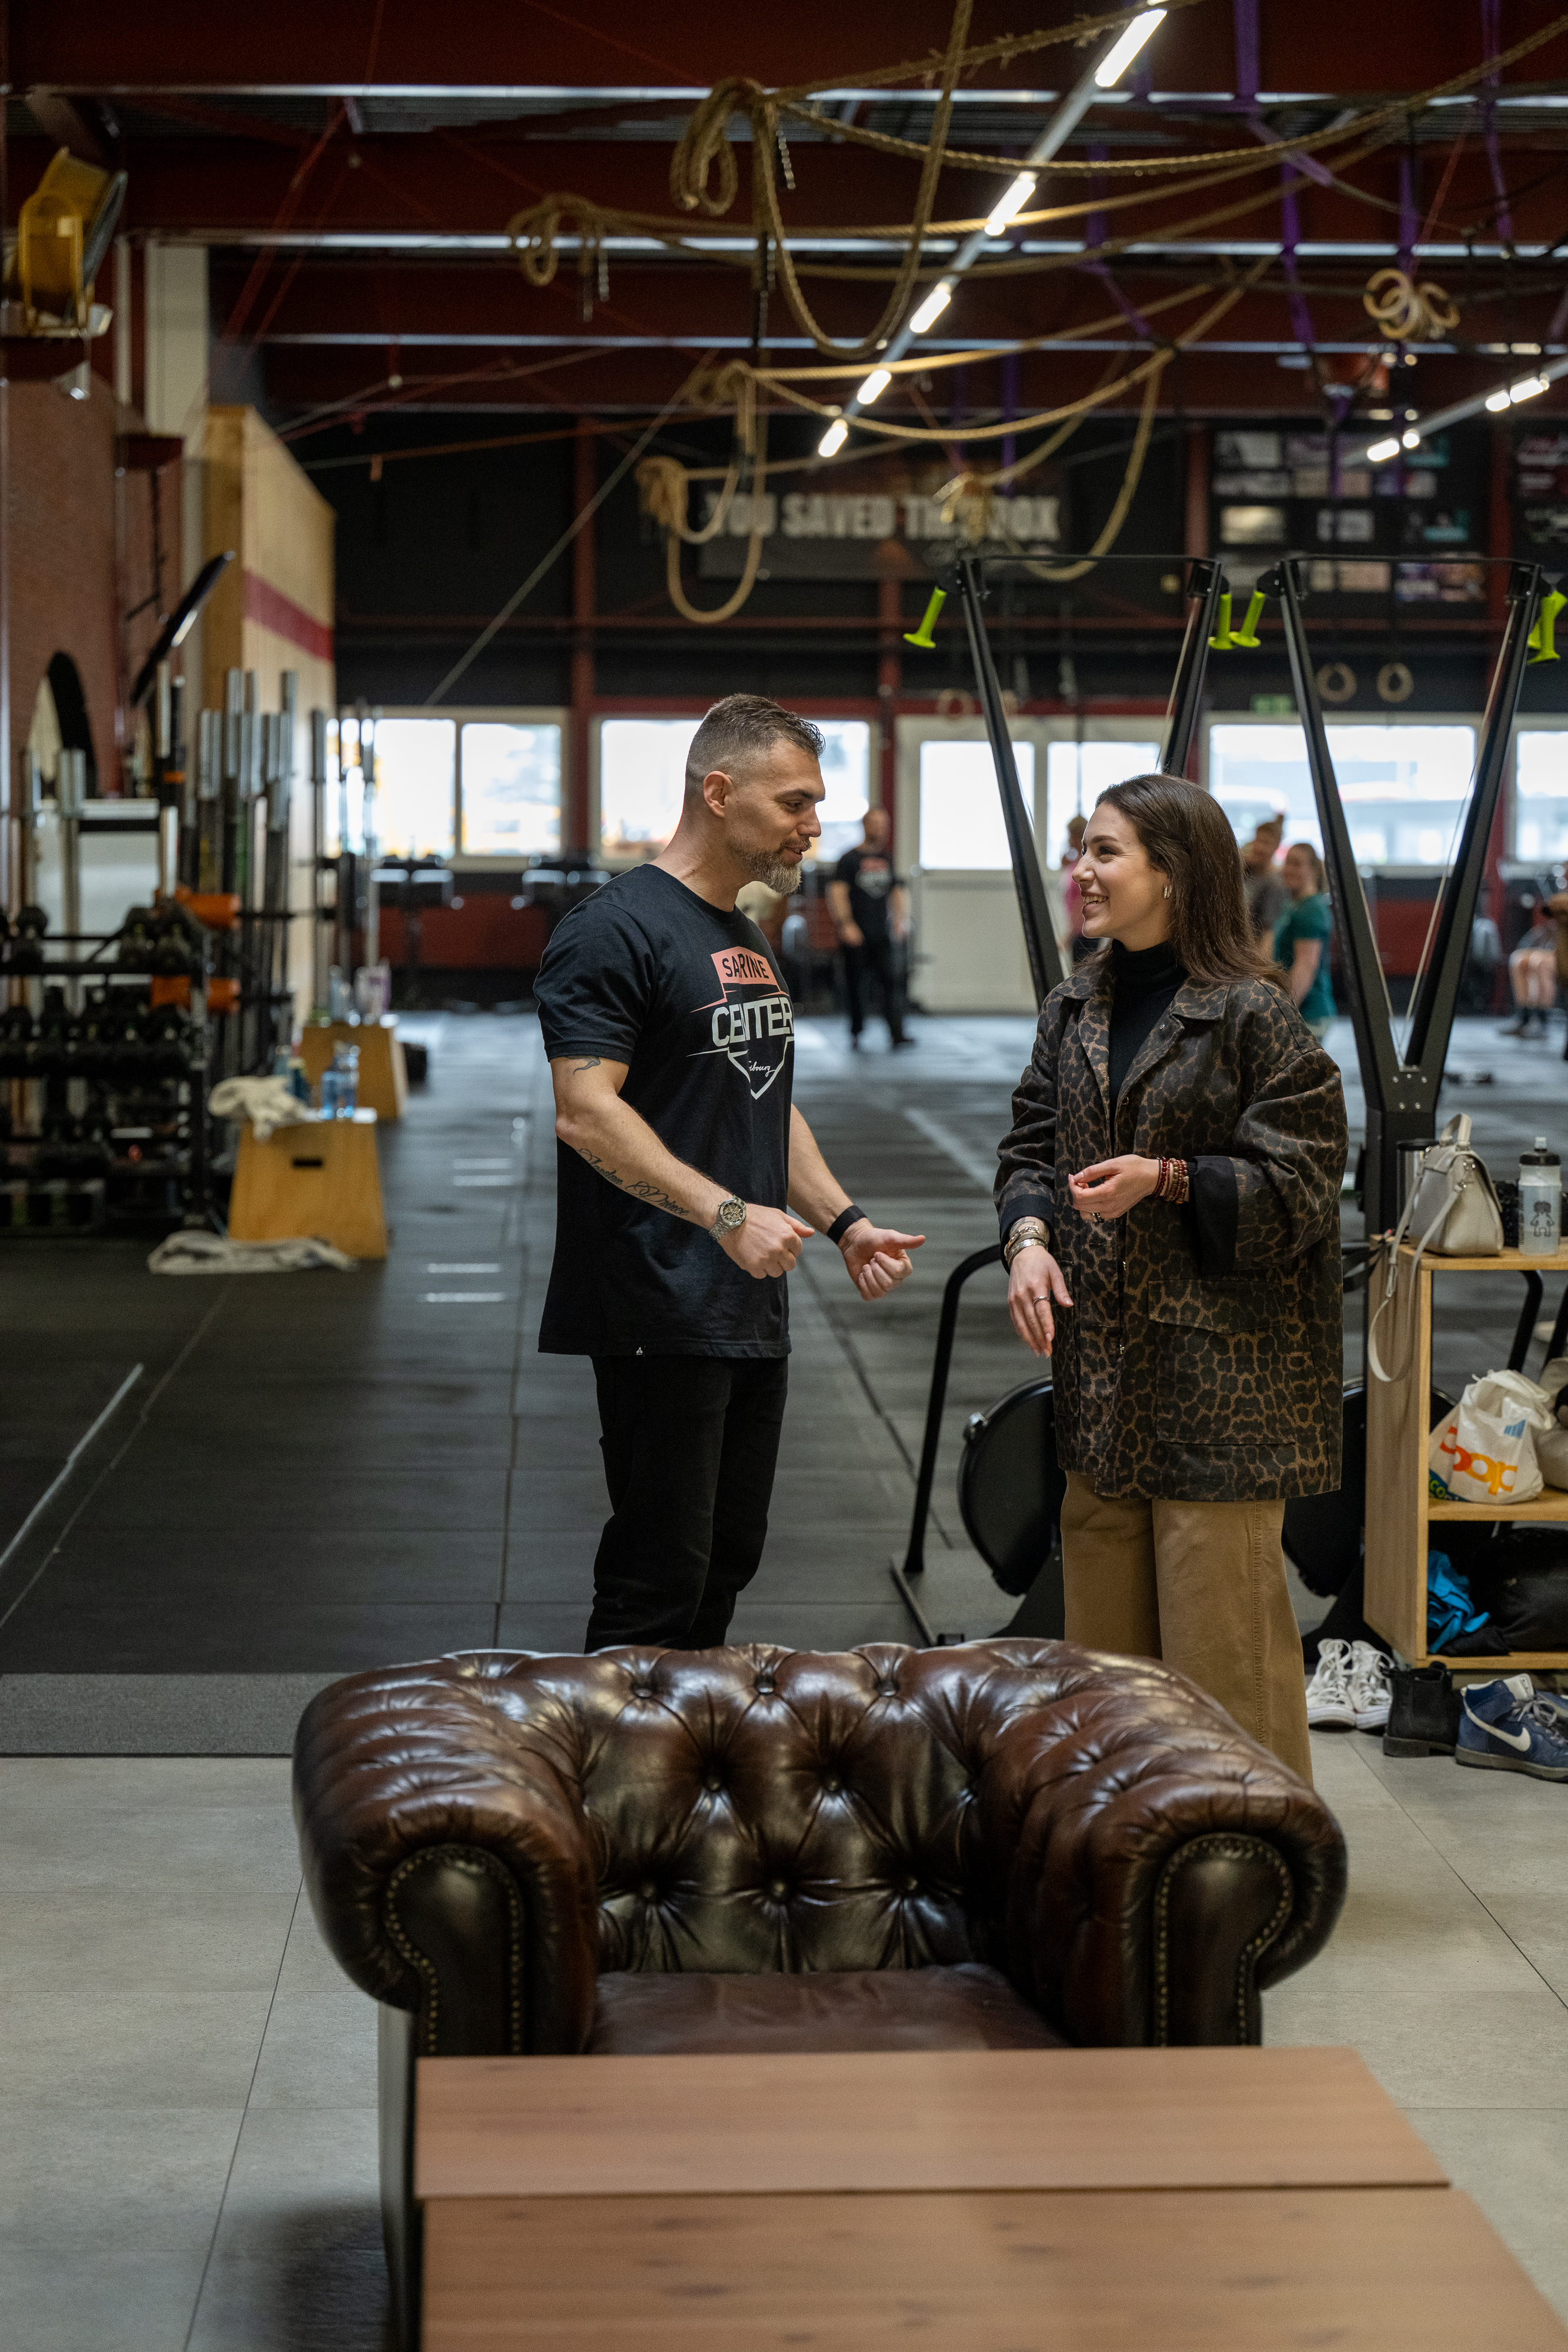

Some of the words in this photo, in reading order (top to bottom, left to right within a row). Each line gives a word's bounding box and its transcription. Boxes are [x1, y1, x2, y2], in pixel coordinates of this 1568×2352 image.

[781, 492, 895, 539] SAVED
[721, 953, 770, 979] SARINE
[711, 997, 794, 1047] CENTER
[748, 1060, 776, 1077] ibourg
